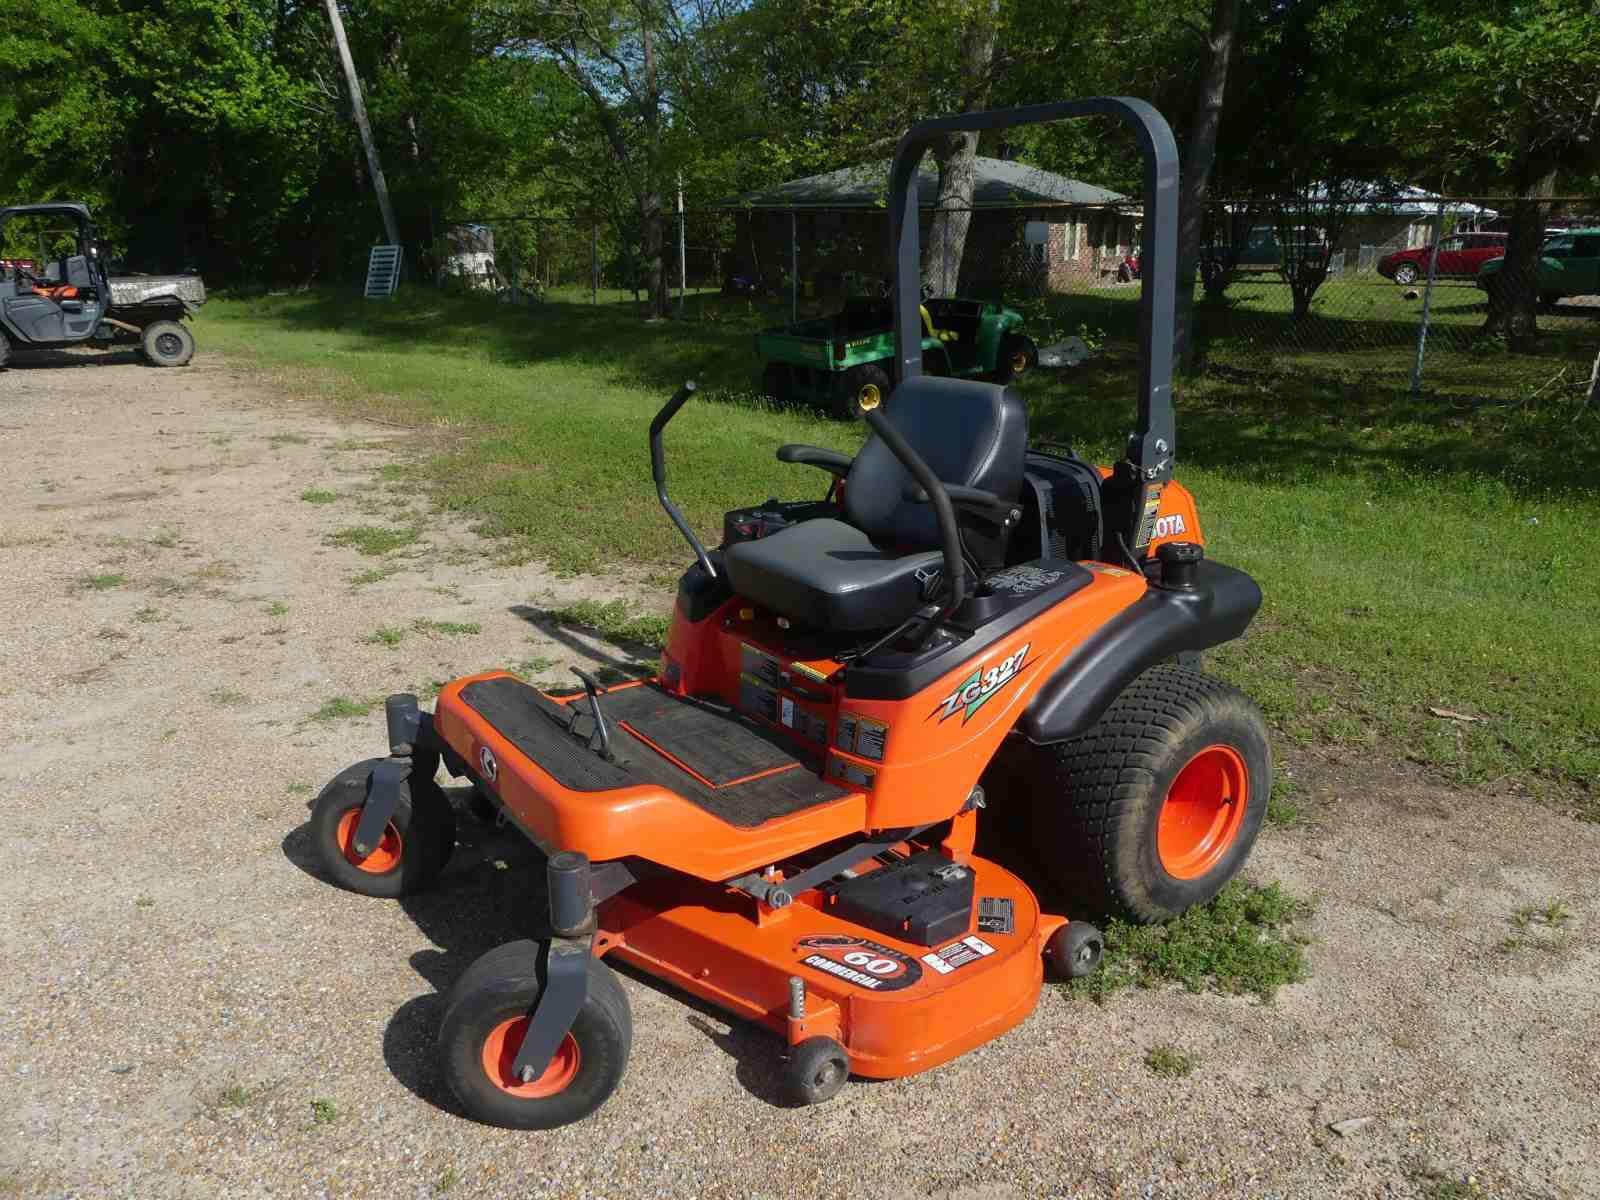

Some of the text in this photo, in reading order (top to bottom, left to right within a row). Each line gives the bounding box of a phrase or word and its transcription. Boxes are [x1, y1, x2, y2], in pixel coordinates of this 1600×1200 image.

[1151, 514, 1185, 538] OTA
[939, 642, 1031, 723] ZG327
[804, 956, 883, 989] COMMERCIAL
[843, 952, 898, 974] 60
